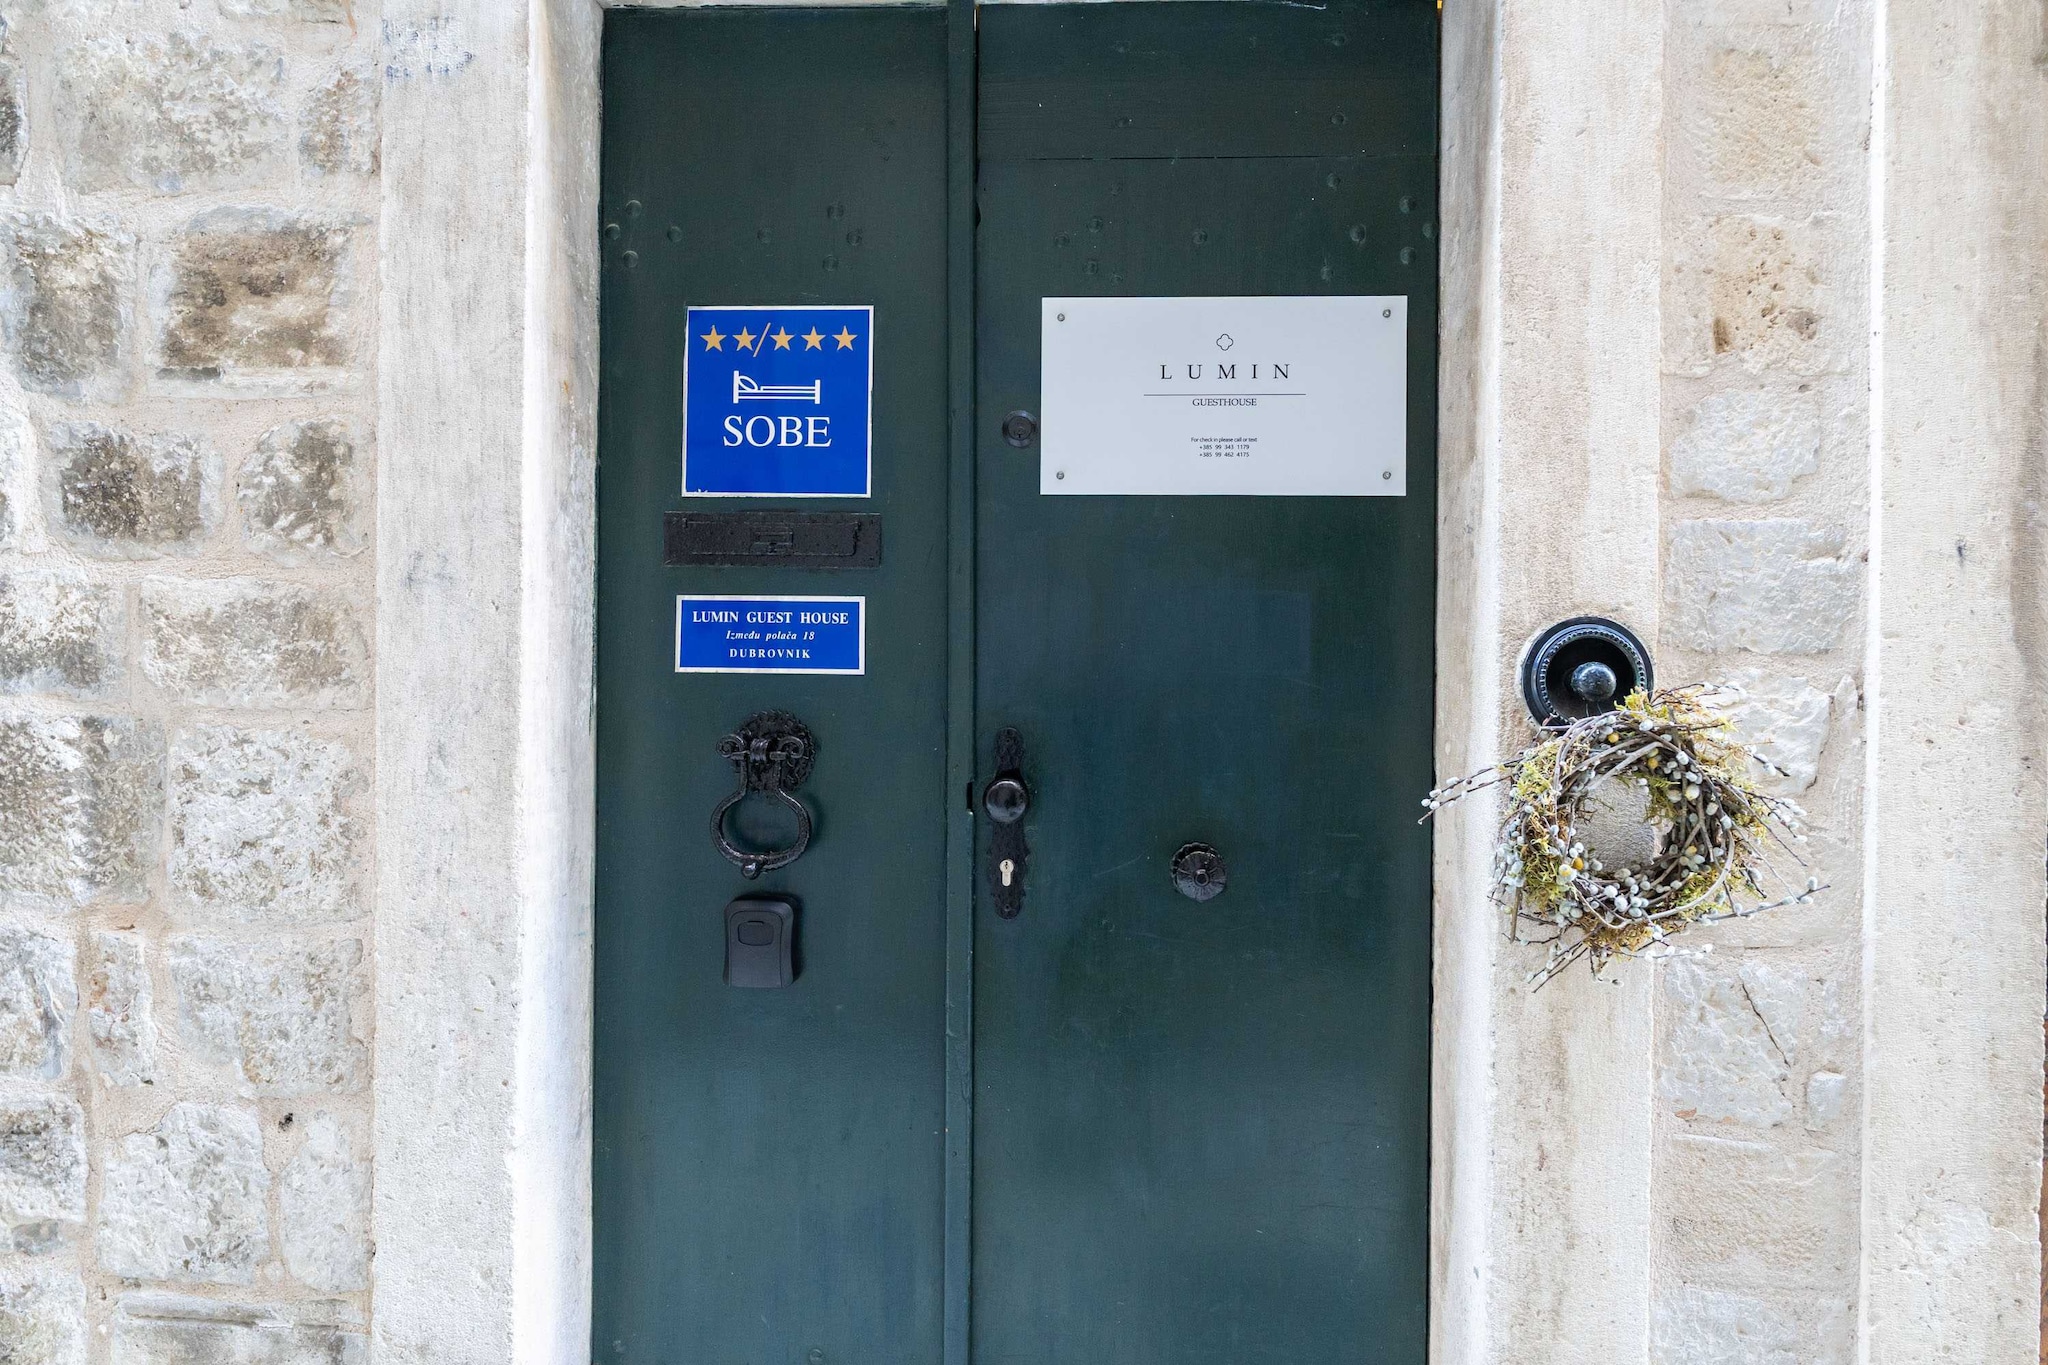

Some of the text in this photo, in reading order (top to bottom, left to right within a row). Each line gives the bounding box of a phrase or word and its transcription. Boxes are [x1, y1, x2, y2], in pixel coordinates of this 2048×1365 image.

[1160, 363, 1290, 380] LUMIN
[1191, 398, 1257, 407] GUESTHOUSE
[722, 415, 832, 447] SOBE
[692, 610, 849, 625] LUMIN GUEST HOUSE
[765, 630, 798, 642] polača
[803, 631, 816, 640] 18
[729, 648, 811, 659] DUBROVNIK
